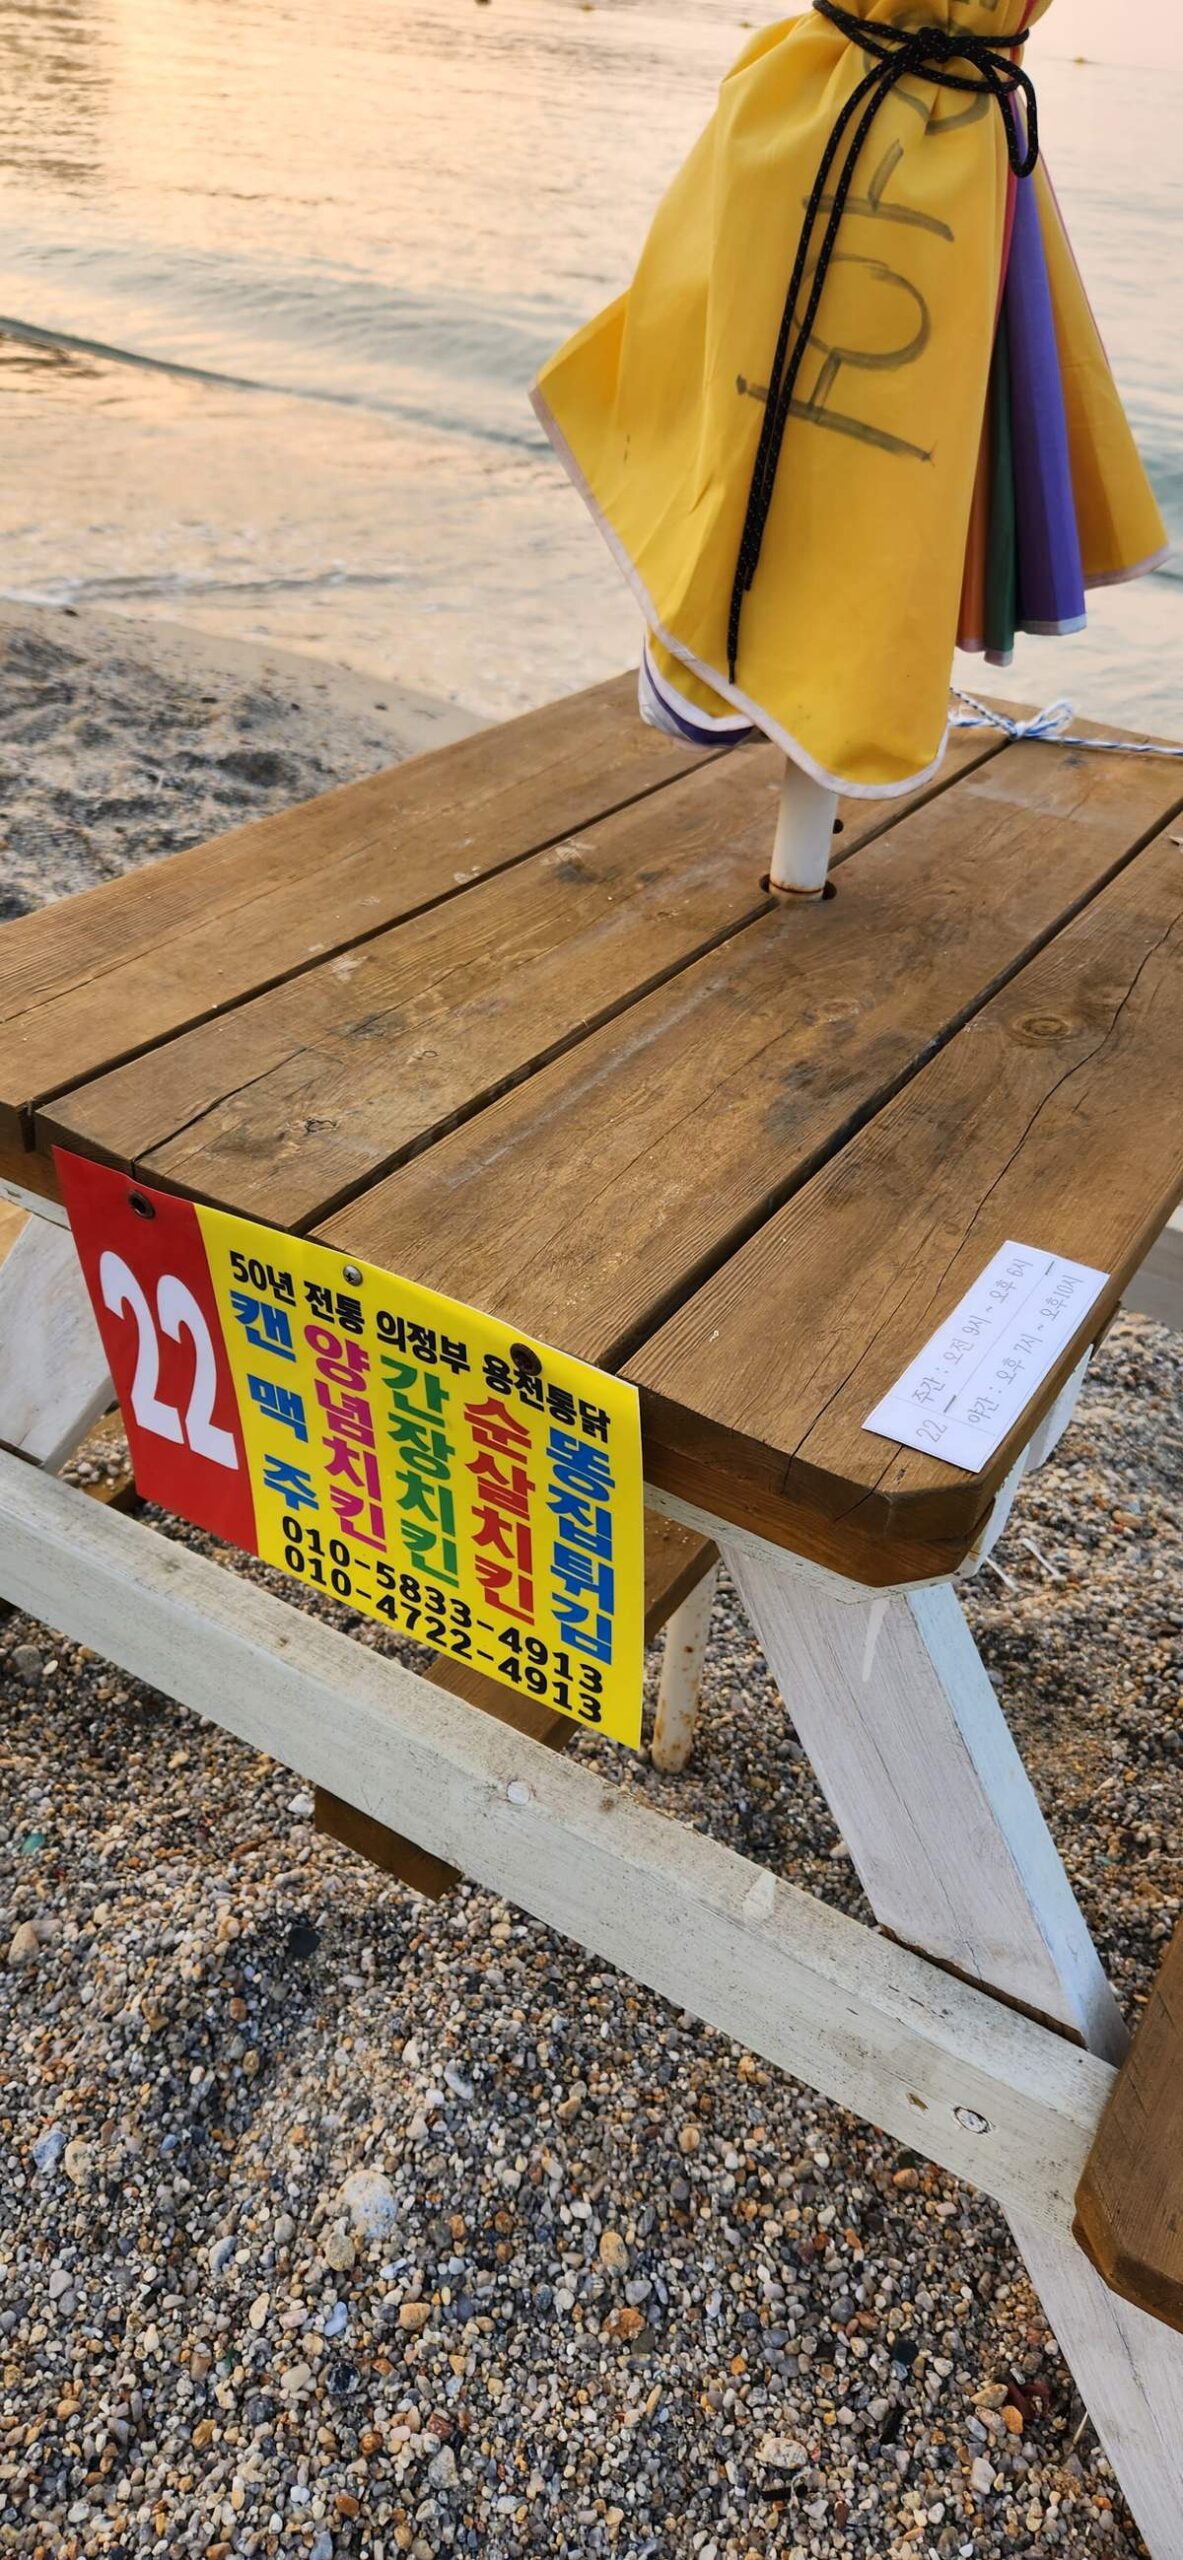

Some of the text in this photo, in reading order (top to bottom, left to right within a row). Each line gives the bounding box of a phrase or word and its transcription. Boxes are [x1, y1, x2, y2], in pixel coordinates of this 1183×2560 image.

[99, 1250, 239, 1470] 22
[230, 1250, 611, 1443] 50년 전통 의정부 용천통닭
[912, 1376, 946, 1404] 주간
[944, 1336, 975, 1365] 오전
[962, 1315, 993, 1336] 9시
[990, 1279, 1016, 1303] 오후
[1006, 1258, 1034, 1279] 6시
[967, 1396, 1000, 1424] 야간
[996, 1357, 1026, 1385] 오후
[1014, 1333, 1043, 1354] 7시
[304, 1324, 387, 1553] 양념치킨
[380, 1355, 459, 1589] 간장치킨
[464, 1397, 535, 1626] 순살치킨
[916, 1419, 948, 1443] 22
[283, 1516, 603, 1694] 010-5833-4913
[285, 1545, 601, 1723] 010-4722-4913
[546, 1427, 615, 1665] 똥집튀김
